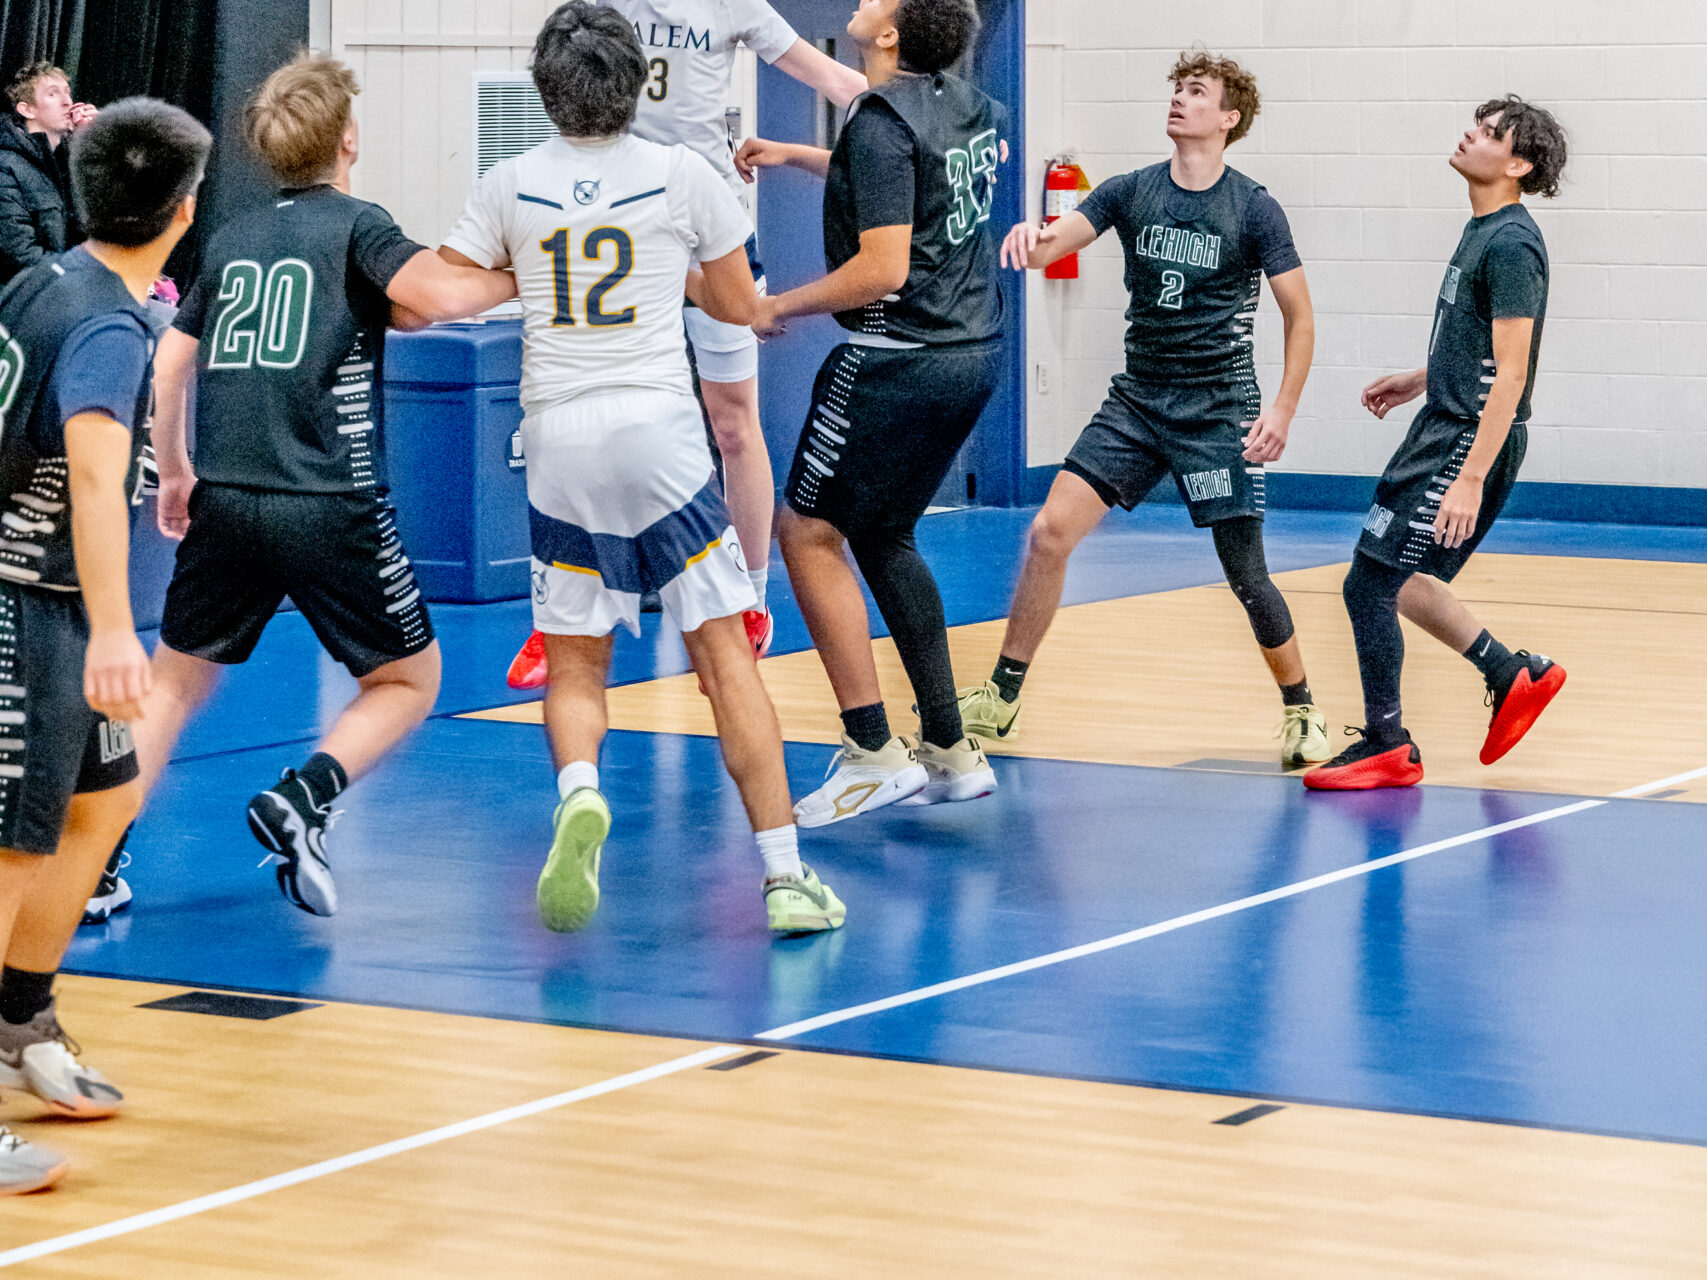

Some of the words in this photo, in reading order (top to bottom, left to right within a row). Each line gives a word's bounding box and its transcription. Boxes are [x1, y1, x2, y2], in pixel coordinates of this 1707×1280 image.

[633, 20, 710, 52] ALEM
[1136, 225, 1221, 270] LEHIGH
[540, 225, 638, 329] 12
[1157, 270, 1185, 310] 2
[208, 258, 314, 370] 20
[1182, 468, 1233, 502] LEHIGH
[1363, 502, 1395, 538] IGH
